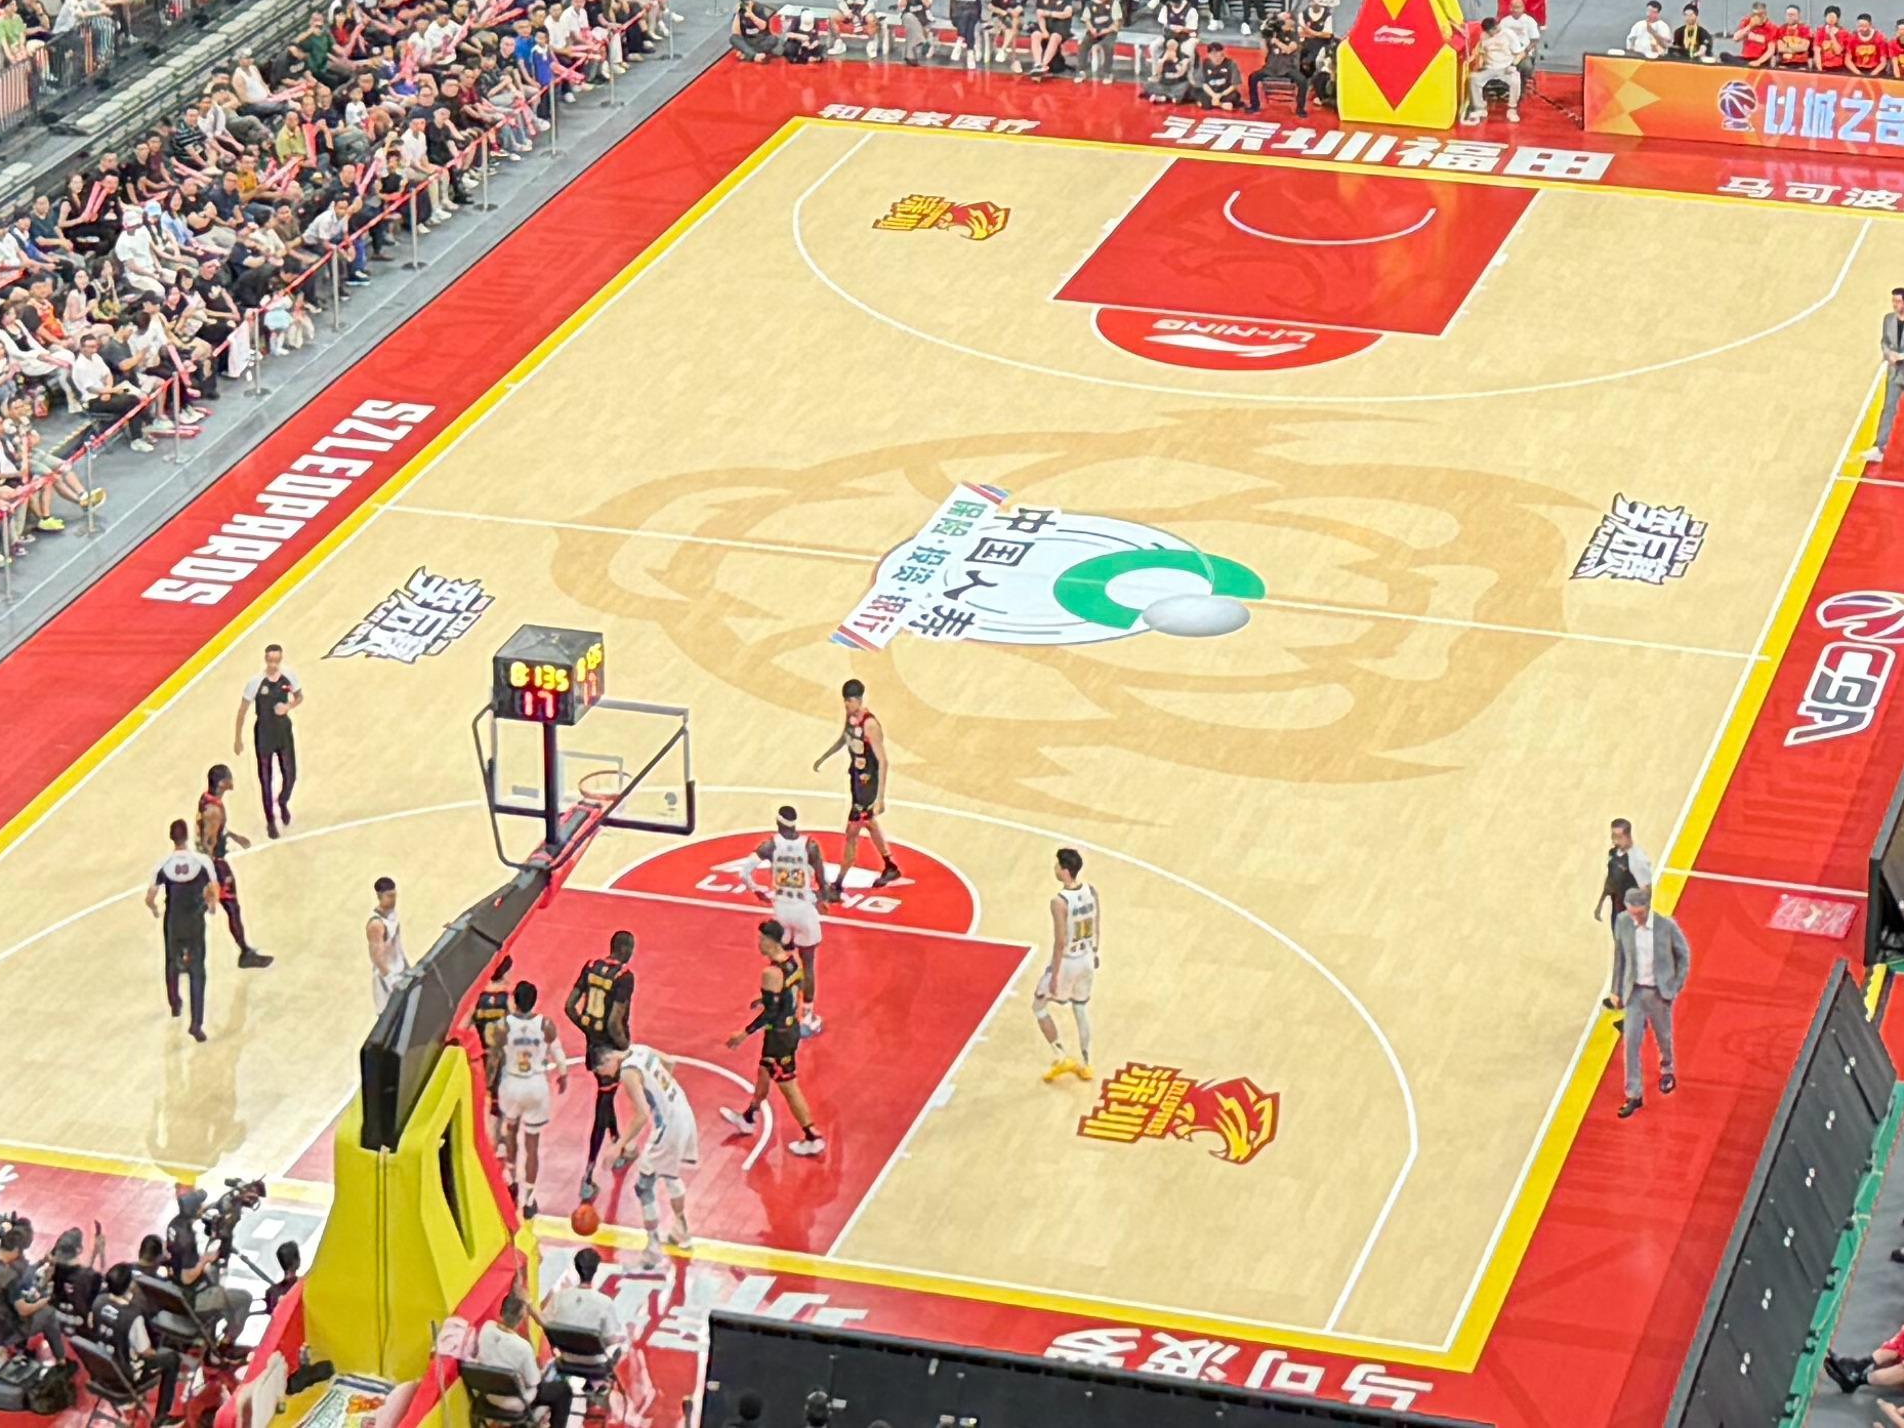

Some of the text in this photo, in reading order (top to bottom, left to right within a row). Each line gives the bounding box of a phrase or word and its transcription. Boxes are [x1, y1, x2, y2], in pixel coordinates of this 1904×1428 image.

[1151, 116, 1615, 181] 深圳福田
[908, 507, 1057, 637] 中国人寿
[524, 690, 555, 719] 17
[1783, 638, 1896, 746] CBA
